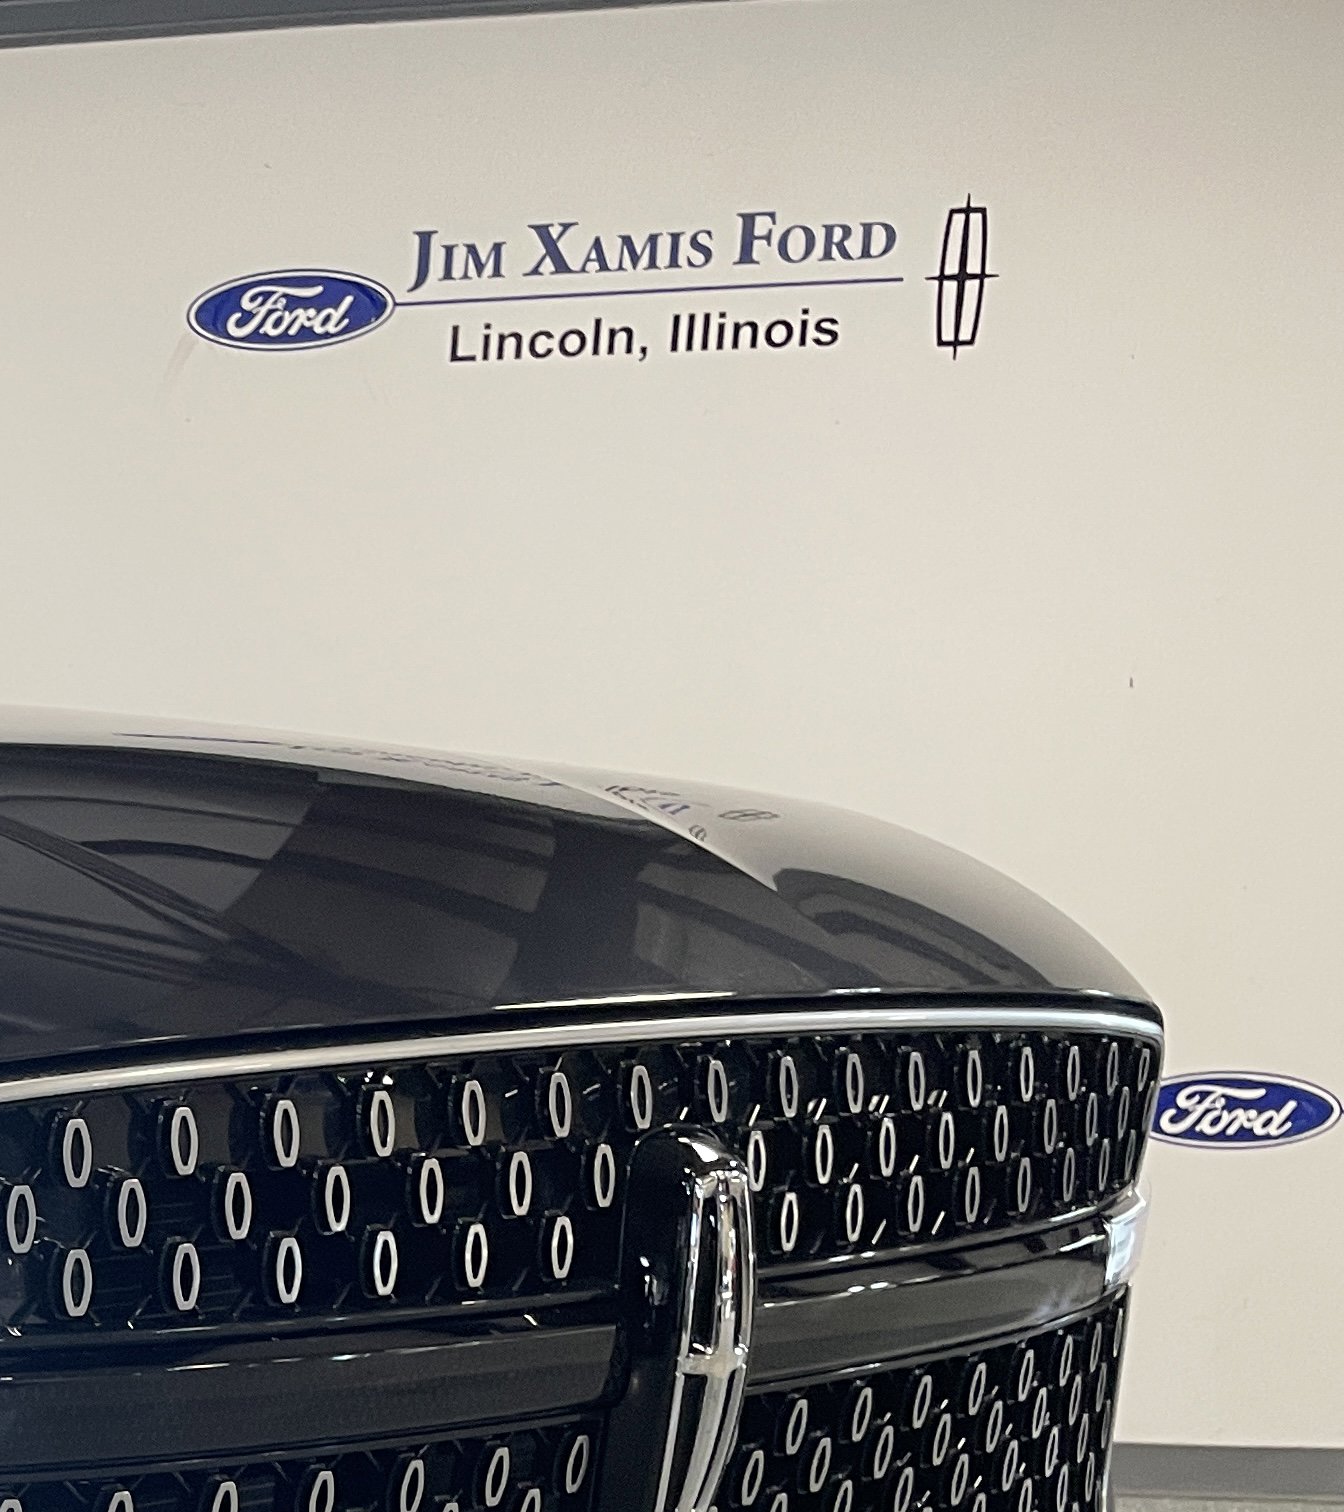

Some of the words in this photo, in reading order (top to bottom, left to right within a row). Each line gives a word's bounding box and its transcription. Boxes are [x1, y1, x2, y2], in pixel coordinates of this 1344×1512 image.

[406, 228, 506, 293] JIM
[523, 221, 713, 277] XAMIS
[735, 211, 898, 266] FORD
[226, 286, 349, 336] Ford
[448, 316, 650, 363] Lincoln,
[668, 308, 841, 354] Illinois
[1159, 1084, 1298, 1138] Ford
